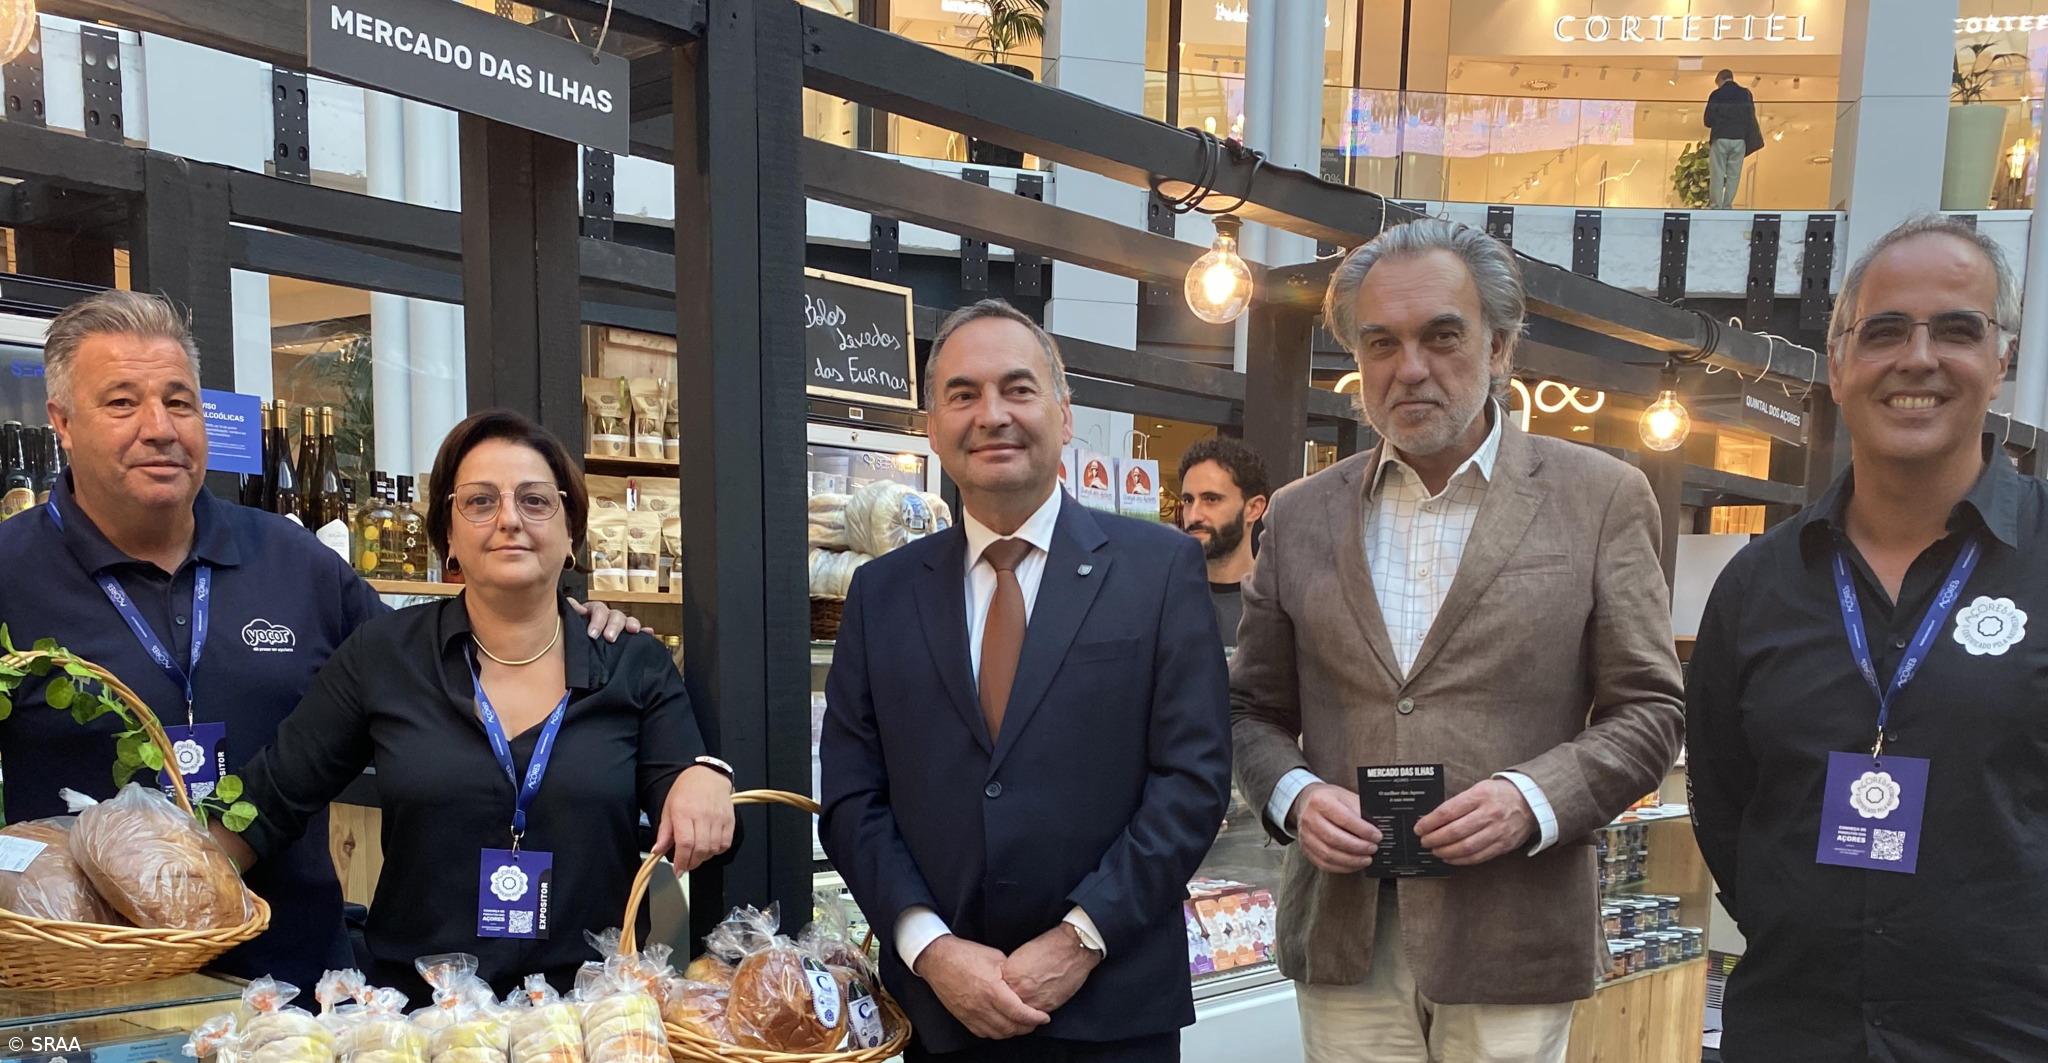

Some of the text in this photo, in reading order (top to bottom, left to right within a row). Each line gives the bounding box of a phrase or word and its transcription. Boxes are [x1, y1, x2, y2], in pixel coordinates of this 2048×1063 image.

[1553, 14, 1815, 43] CORTEFIEL
[331, 5, 614, 114] MERCADO DAS ILHAS
[804, 293, 847, 329] Bolos
[814, 357, 845, 382] das
[1746, 395, 1800, 426] QUINTAL DOS AÇORES
[217, 752, 226, 777] SITOR
[1367, 766, 1434, 777] MERCADO DAS ILHAS
[1837, 835, 1866, 843] AÇORES
[539, 882, 549, 930] EXPOSITOR
